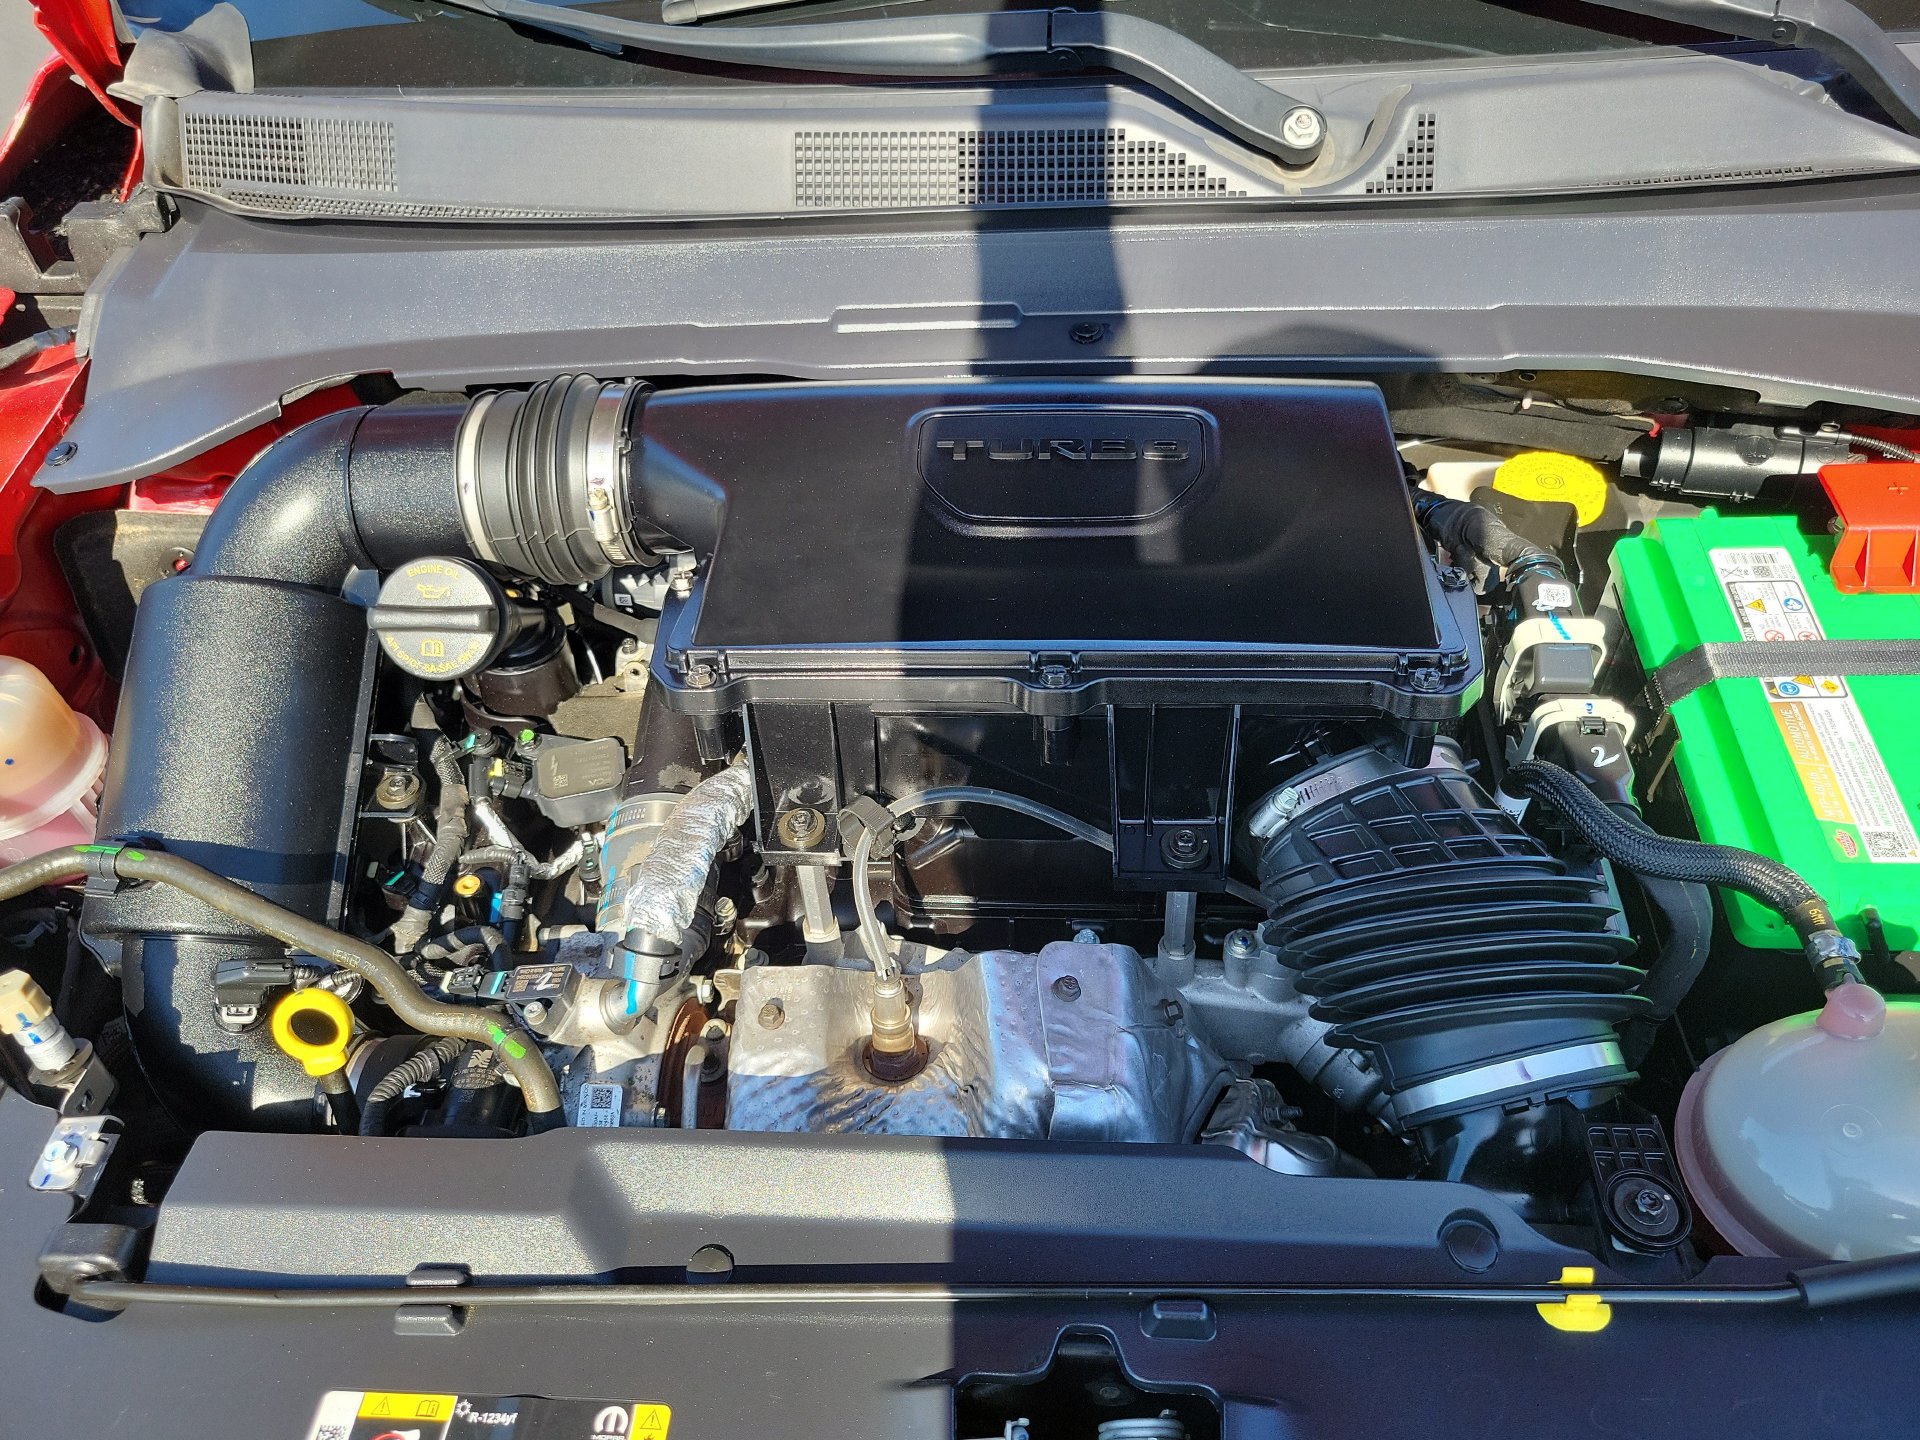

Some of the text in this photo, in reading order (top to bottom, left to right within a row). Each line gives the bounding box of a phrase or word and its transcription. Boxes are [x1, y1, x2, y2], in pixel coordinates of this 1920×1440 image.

[937, 439, 1189, 460] TURBO
[407, 564, 460, 580] ENGINE OIL
[1779, 708, 1809, 759] AUTOMOTIVE
[1591, 746, 1621, 767] 2
[467, 1411, 518, 1425] R-1234yf
